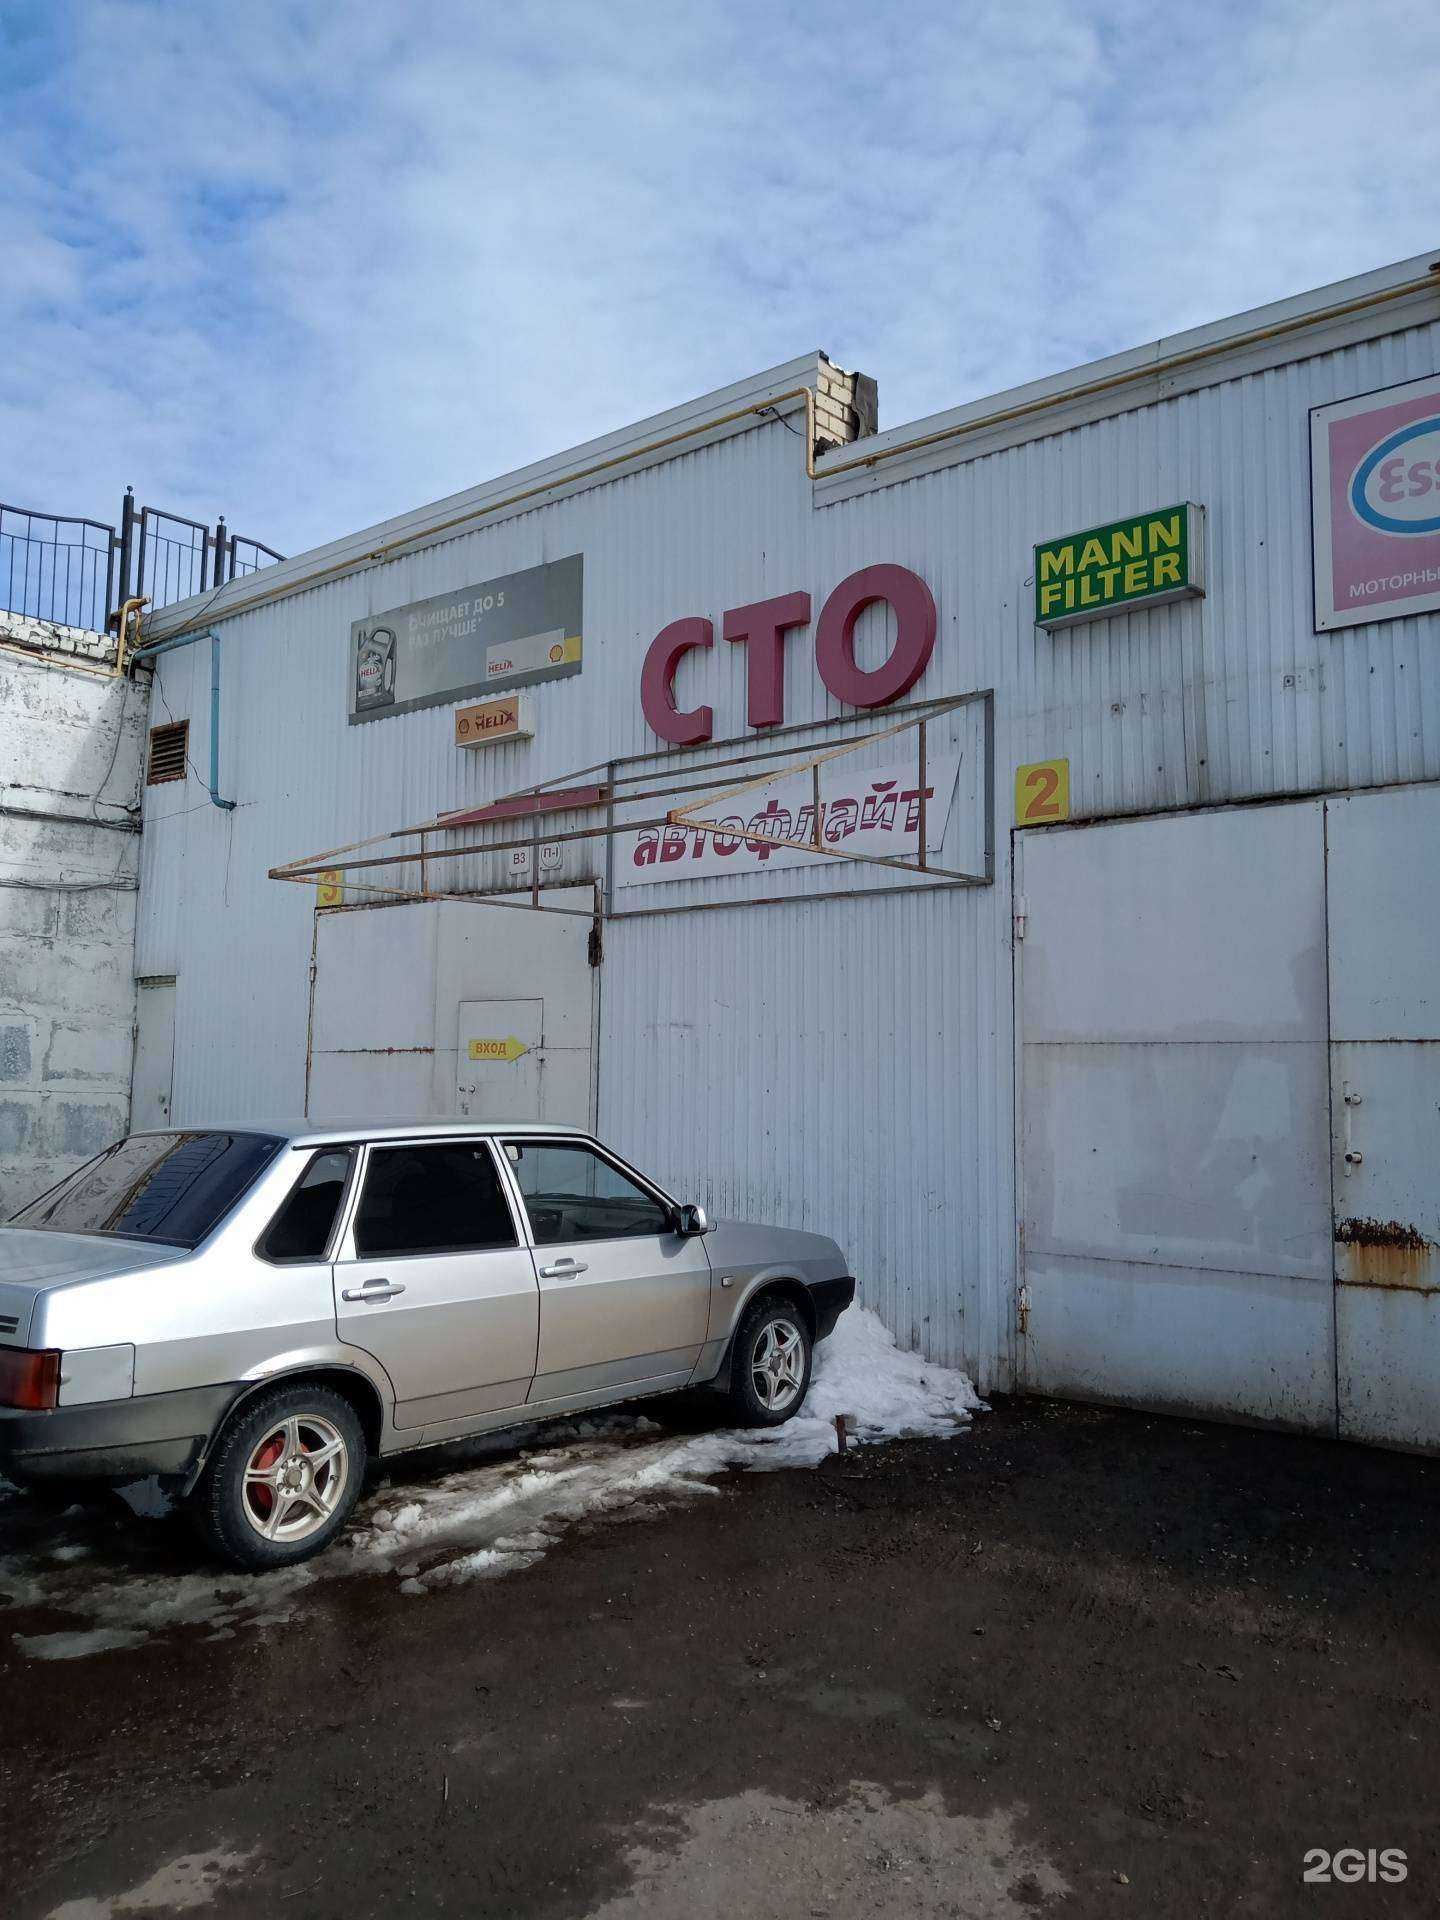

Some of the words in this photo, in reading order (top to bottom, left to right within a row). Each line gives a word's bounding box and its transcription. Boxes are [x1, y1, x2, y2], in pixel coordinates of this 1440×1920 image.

[1040, 515, 1181, 582] MANN
[1040, 552, 1182, 615] FILTER
[408, 602, 470, 631] ОЧИЩАЕТ
[473, 595, 494, 616] ДО
[496, 591, 505, 607] 5
[488, 659, 513, 673] HELIX
[640, 563, 937, 746] СТО
[475, 709, 516, 730] HELIX
[1024, 768, 1060, 819] 2
[475, 1041, 508, 1056] ВХОД
